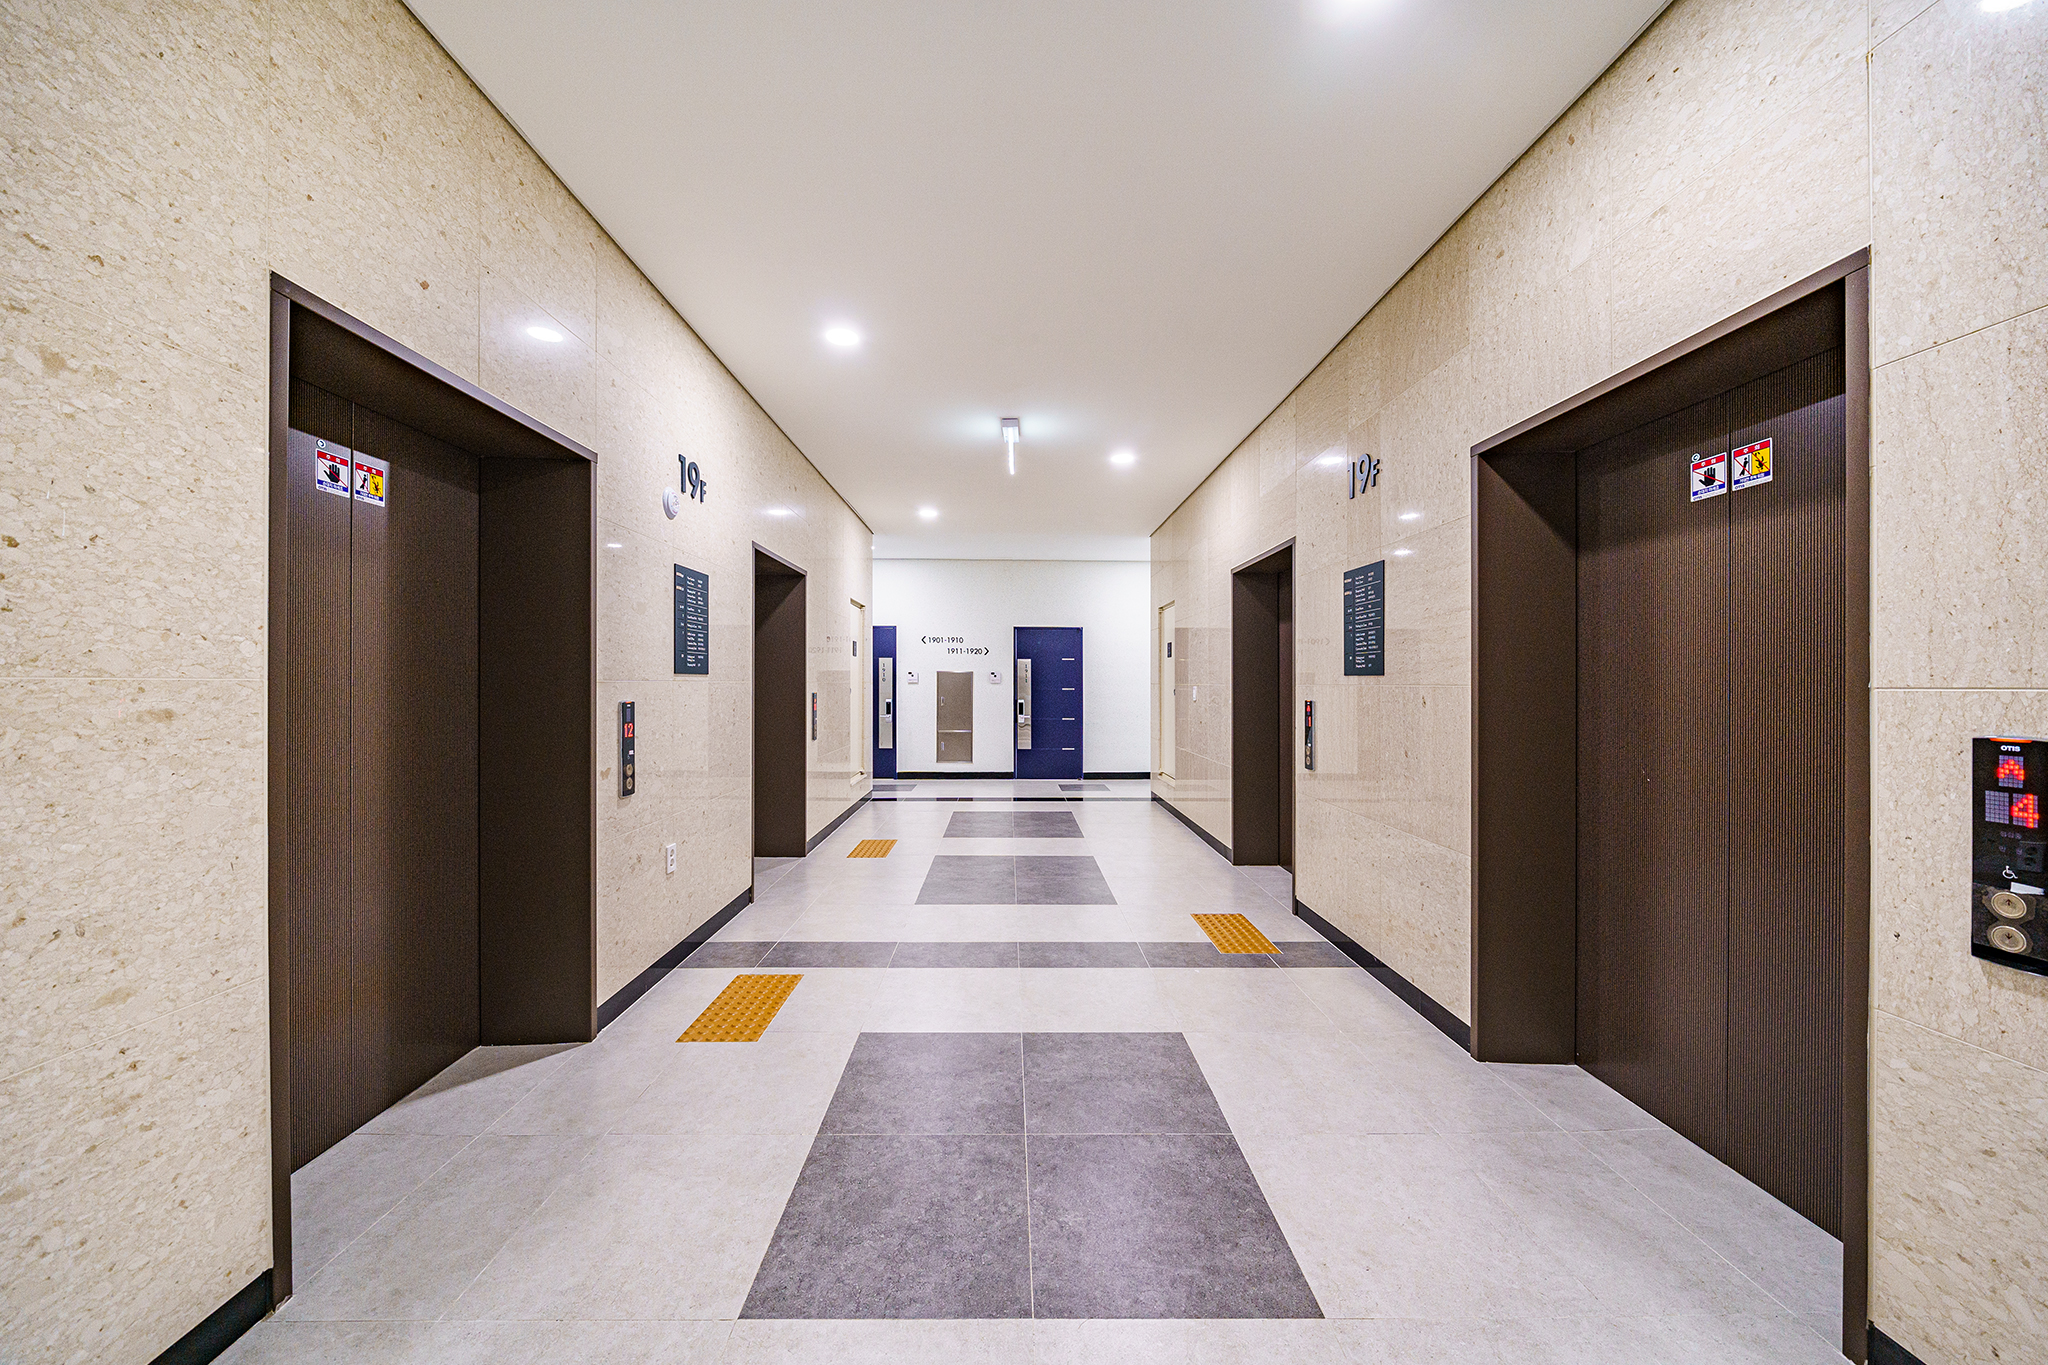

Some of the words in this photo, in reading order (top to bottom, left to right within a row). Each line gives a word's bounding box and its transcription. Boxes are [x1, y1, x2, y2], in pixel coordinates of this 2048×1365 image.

[928, 636, 964, 644] 1901-1910
[947, 647, 983, 655] 1911-1920
[624, 722, 634, 738] 12
[2011, 793, 2040, 828] 4
